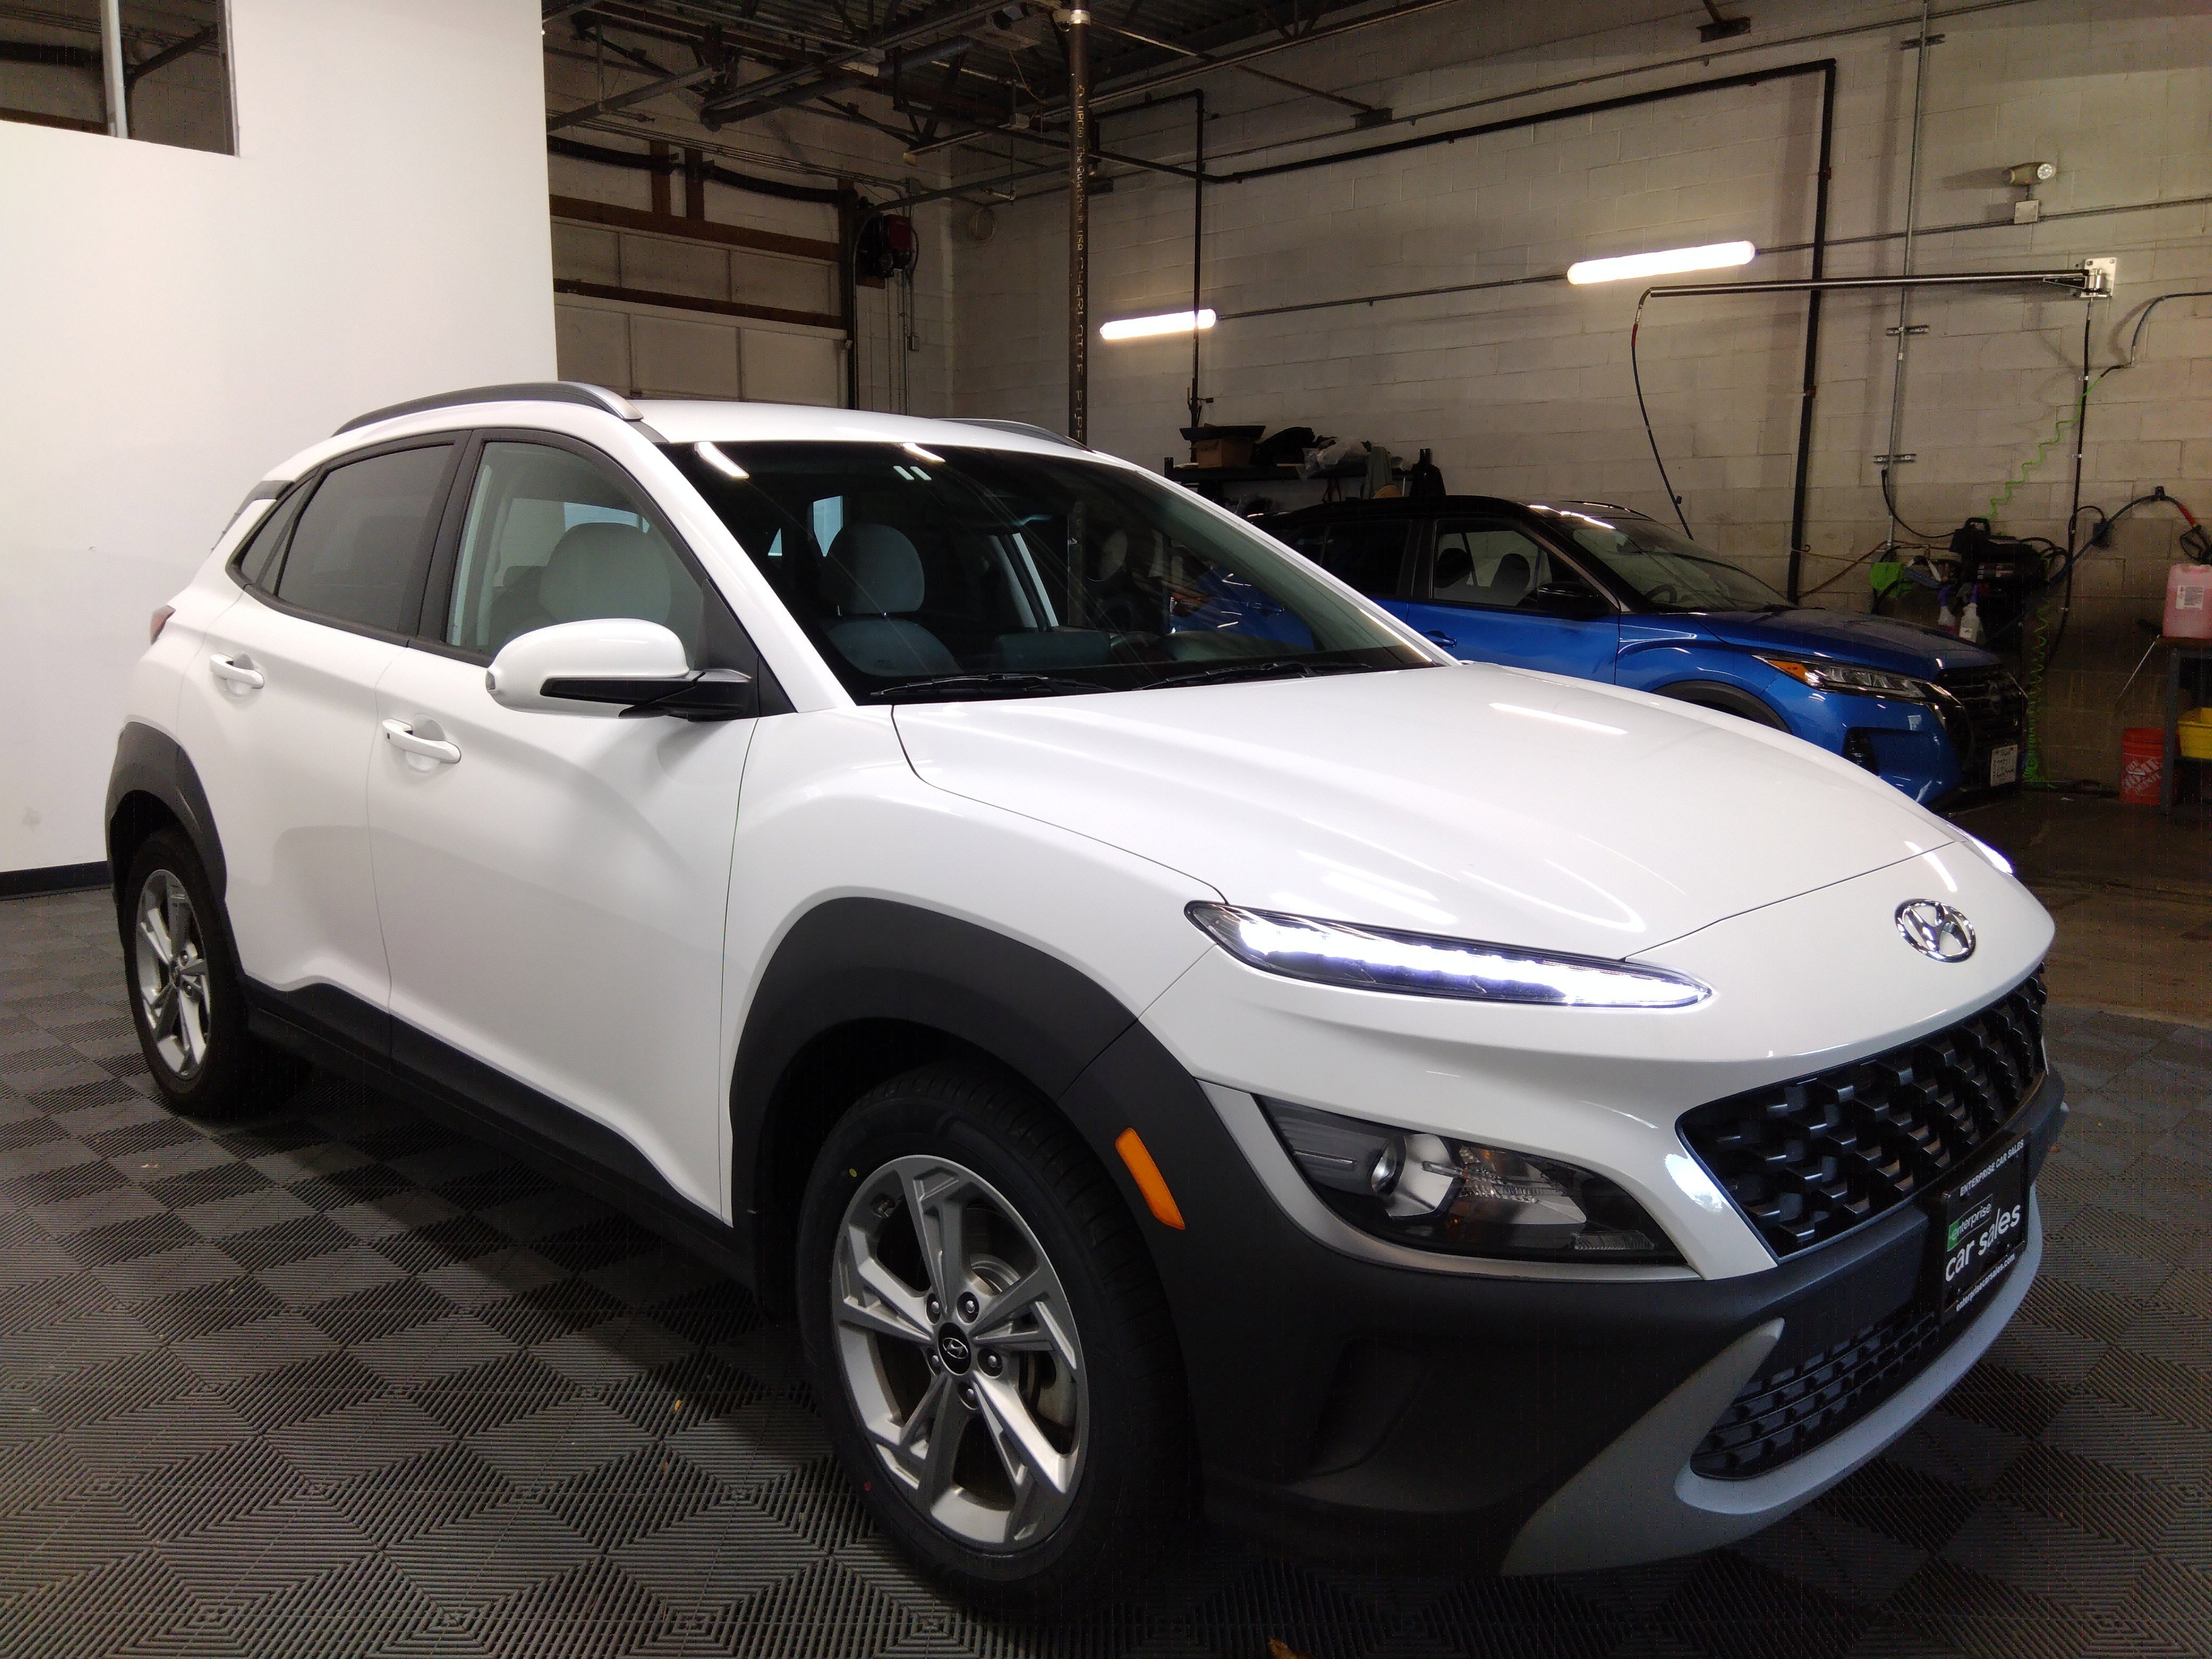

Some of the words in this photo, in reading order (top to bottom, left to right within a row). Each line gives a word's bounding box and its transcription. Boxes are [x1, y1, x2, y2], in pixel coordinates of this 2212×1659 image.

[1959, 1162, 1995, 1197] ENTERPRISE
[1996, 1153, 2007, 1168] CAR
[2008, 1139, 2024, 1158] SALES
[1945, 1239, 1974, 1281] car
[1978, 1204, 2021, 1255] sales
[1949, 1203, 1991, 1241] enterprise
[1956, 1253, 2015, 1312] enterprisecarsales.com
